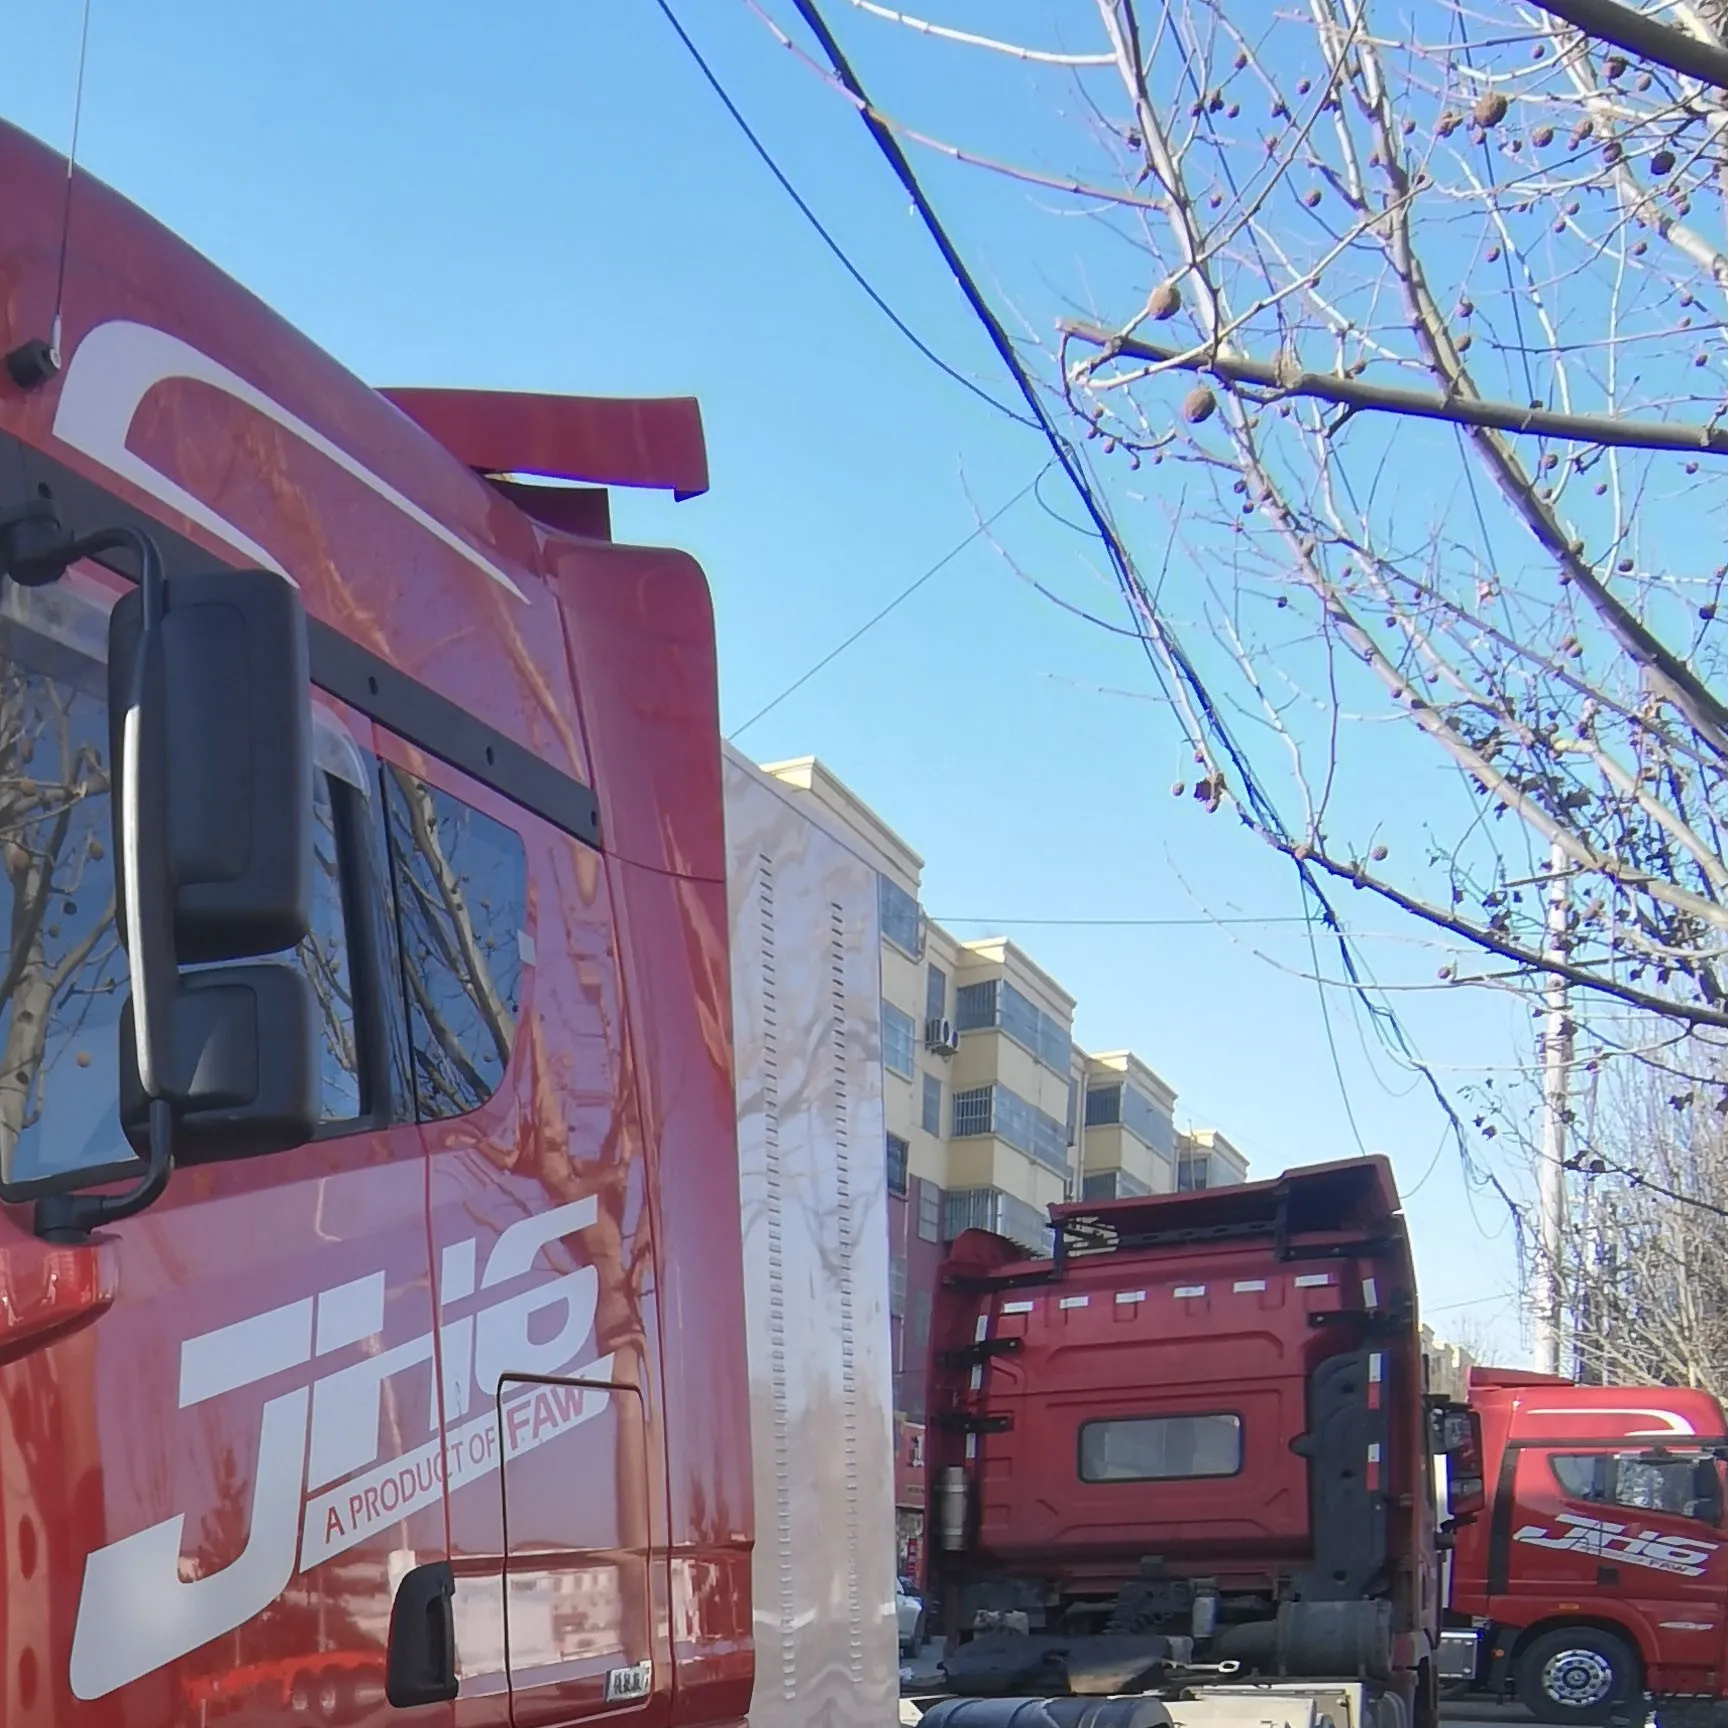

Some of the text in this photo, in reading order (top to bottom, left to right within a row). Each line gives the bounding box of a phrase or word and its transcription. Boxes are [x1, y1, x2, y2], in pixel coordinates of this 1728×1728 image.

[70, 1194, 598, 1701] JH6
[325, 1374, 587, 1545] A PRODUCT OF FAW
[1513, 1513, 1719, 1566] JH6
